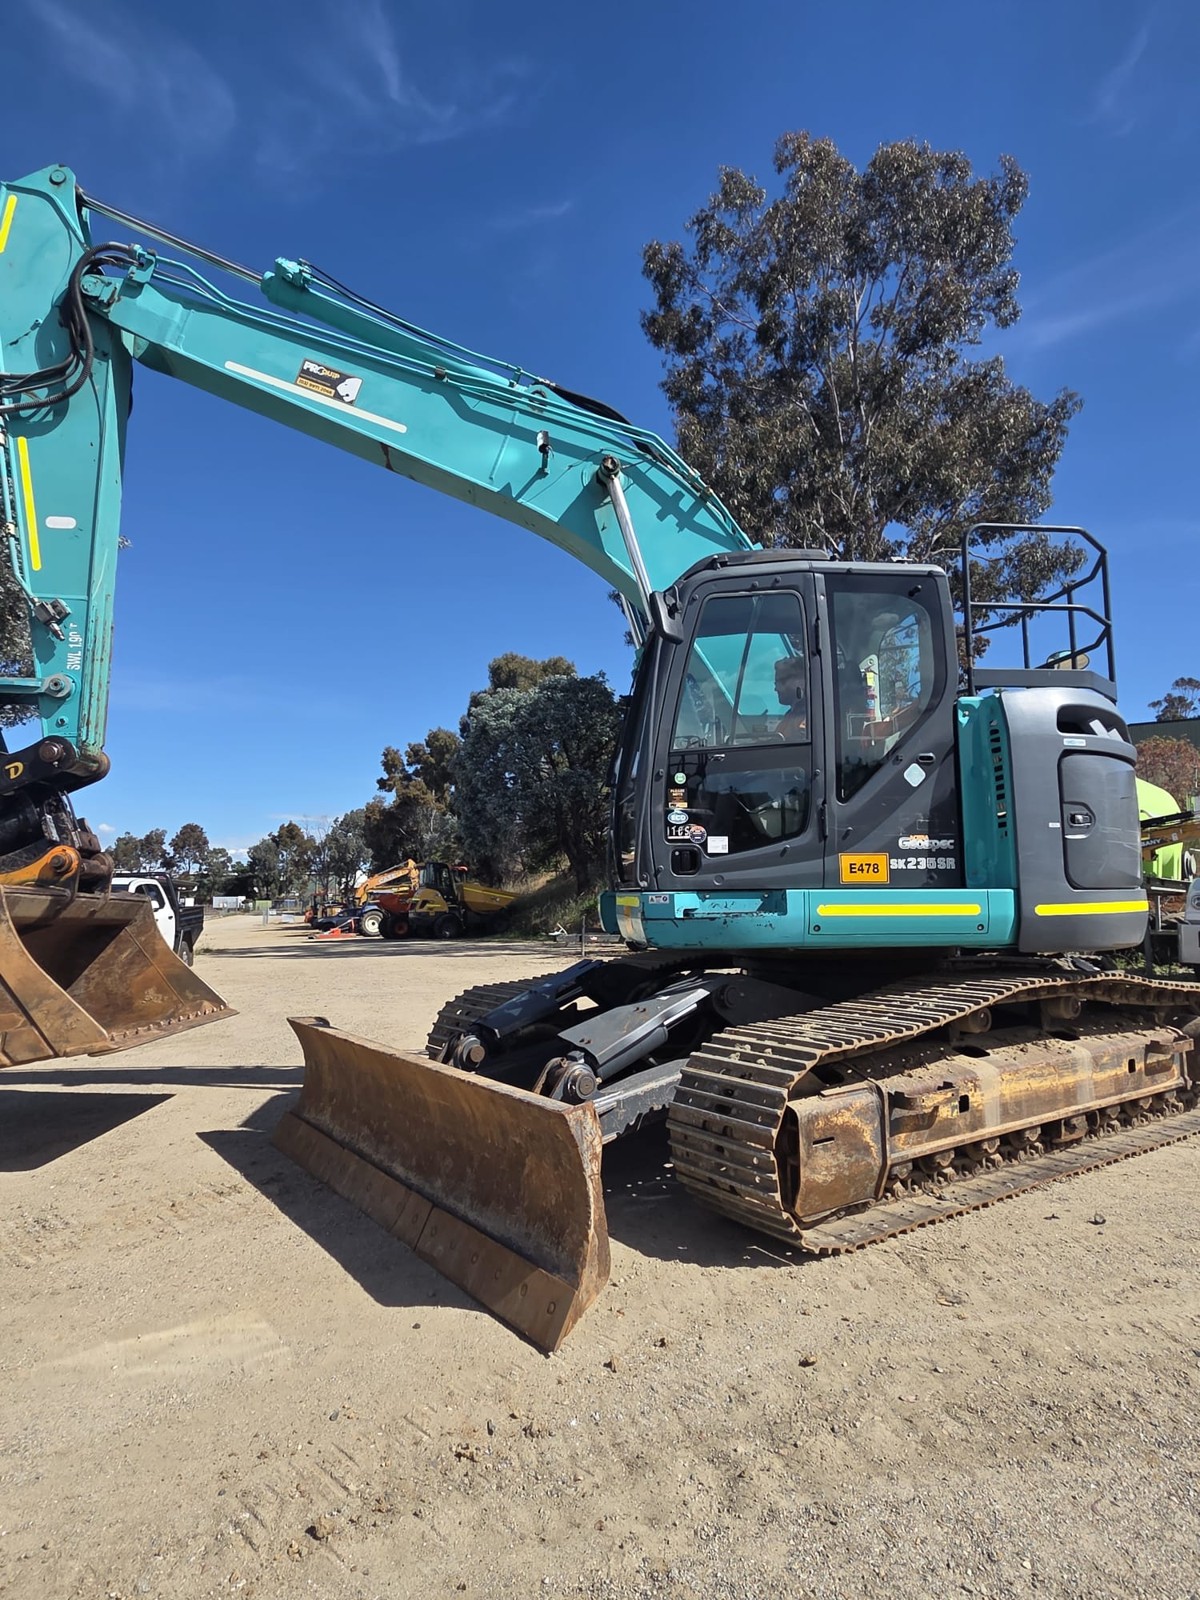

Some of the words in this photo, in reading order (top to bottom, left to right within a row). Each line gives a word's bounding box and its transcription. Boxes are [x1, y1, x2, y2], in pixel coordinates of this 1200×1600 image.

[66, 651, 82, 671] SWL
[849, 863, 880, 874] E478
[890, 857, 956, 870] SK235SR
